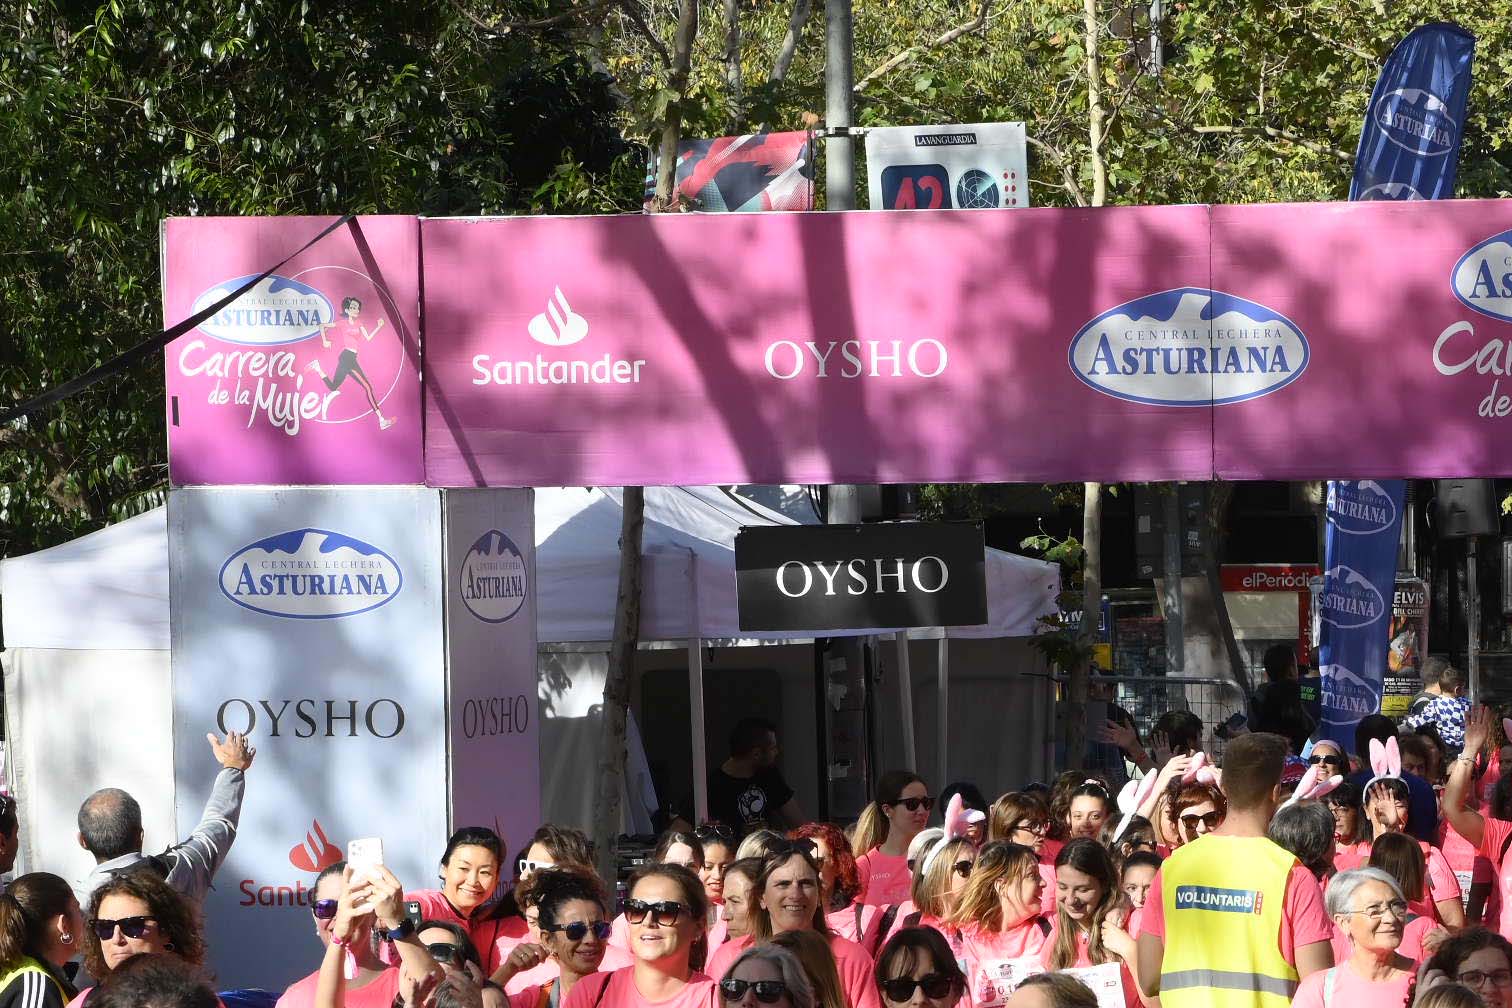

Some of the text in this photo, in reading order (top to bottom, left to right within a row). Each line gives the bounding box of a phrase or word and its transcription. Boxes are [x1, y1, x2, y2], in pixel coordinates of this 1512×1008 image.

[1124, 327, 1283, 342] CENTRAL LECHERA
[178, 340, 297, 378] Carrera
[472, 353, 646, 386] Santander
[764, 338, 949, 379] OYSHO
[1087, 333, 1291, 376] ASTURIANA
[207, 374, 341, 436] de la Mujer
[1478, 380, 1512, 418] de
[233, 562, 390, 596] ASTURIANA
[260, 559, 383, 570] CENTRAL LECHERA
[774, 553, 949, 599] OYSHO
[1242, 570, 1318, 588] elPeriódi
[465, 572, 524, 600] ASTURIANA
[1393, 591, 1425, 604] ELVIS
[216, 698, 406, 739] OYSHO
[461, 694, 529, 739] OYSHO
[1176, 891, 1254, 908] VOLUNTARIS
